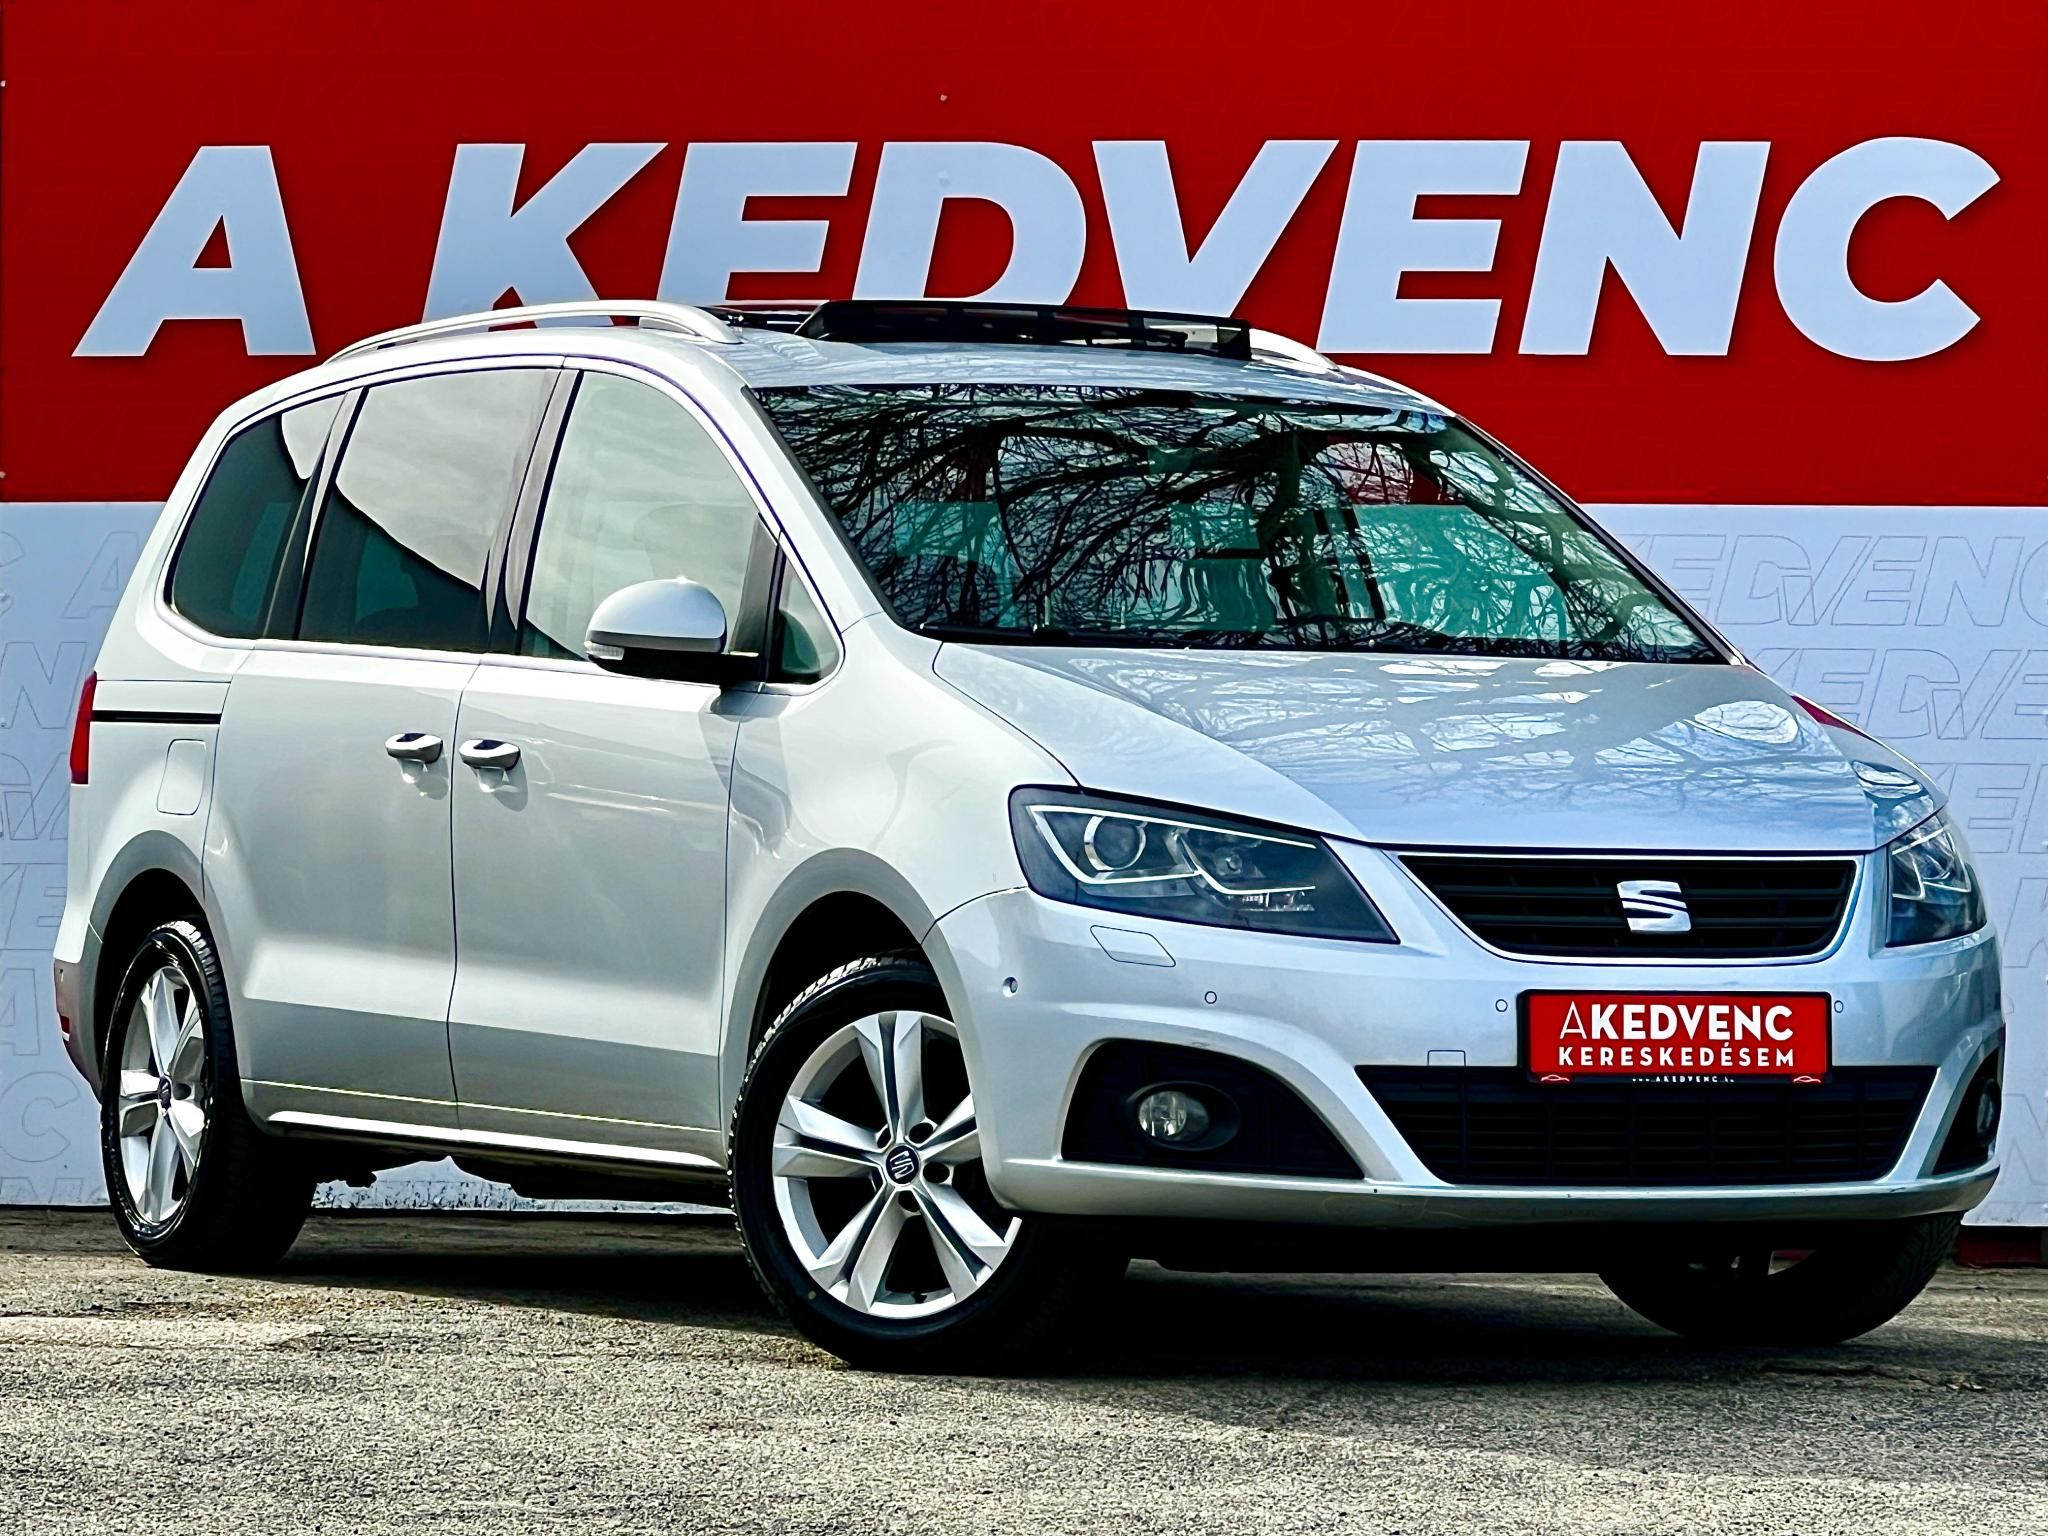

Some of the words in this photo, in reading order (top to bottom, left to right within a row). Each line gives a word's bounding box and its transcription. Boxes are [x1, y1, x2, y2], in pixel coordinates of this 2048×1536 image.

[71, 144, 316, 357] A
[420, 136, 2000, 362] KEDVENC
[1559, 1041, 1794, 1067] KERESKEDÉSEM
